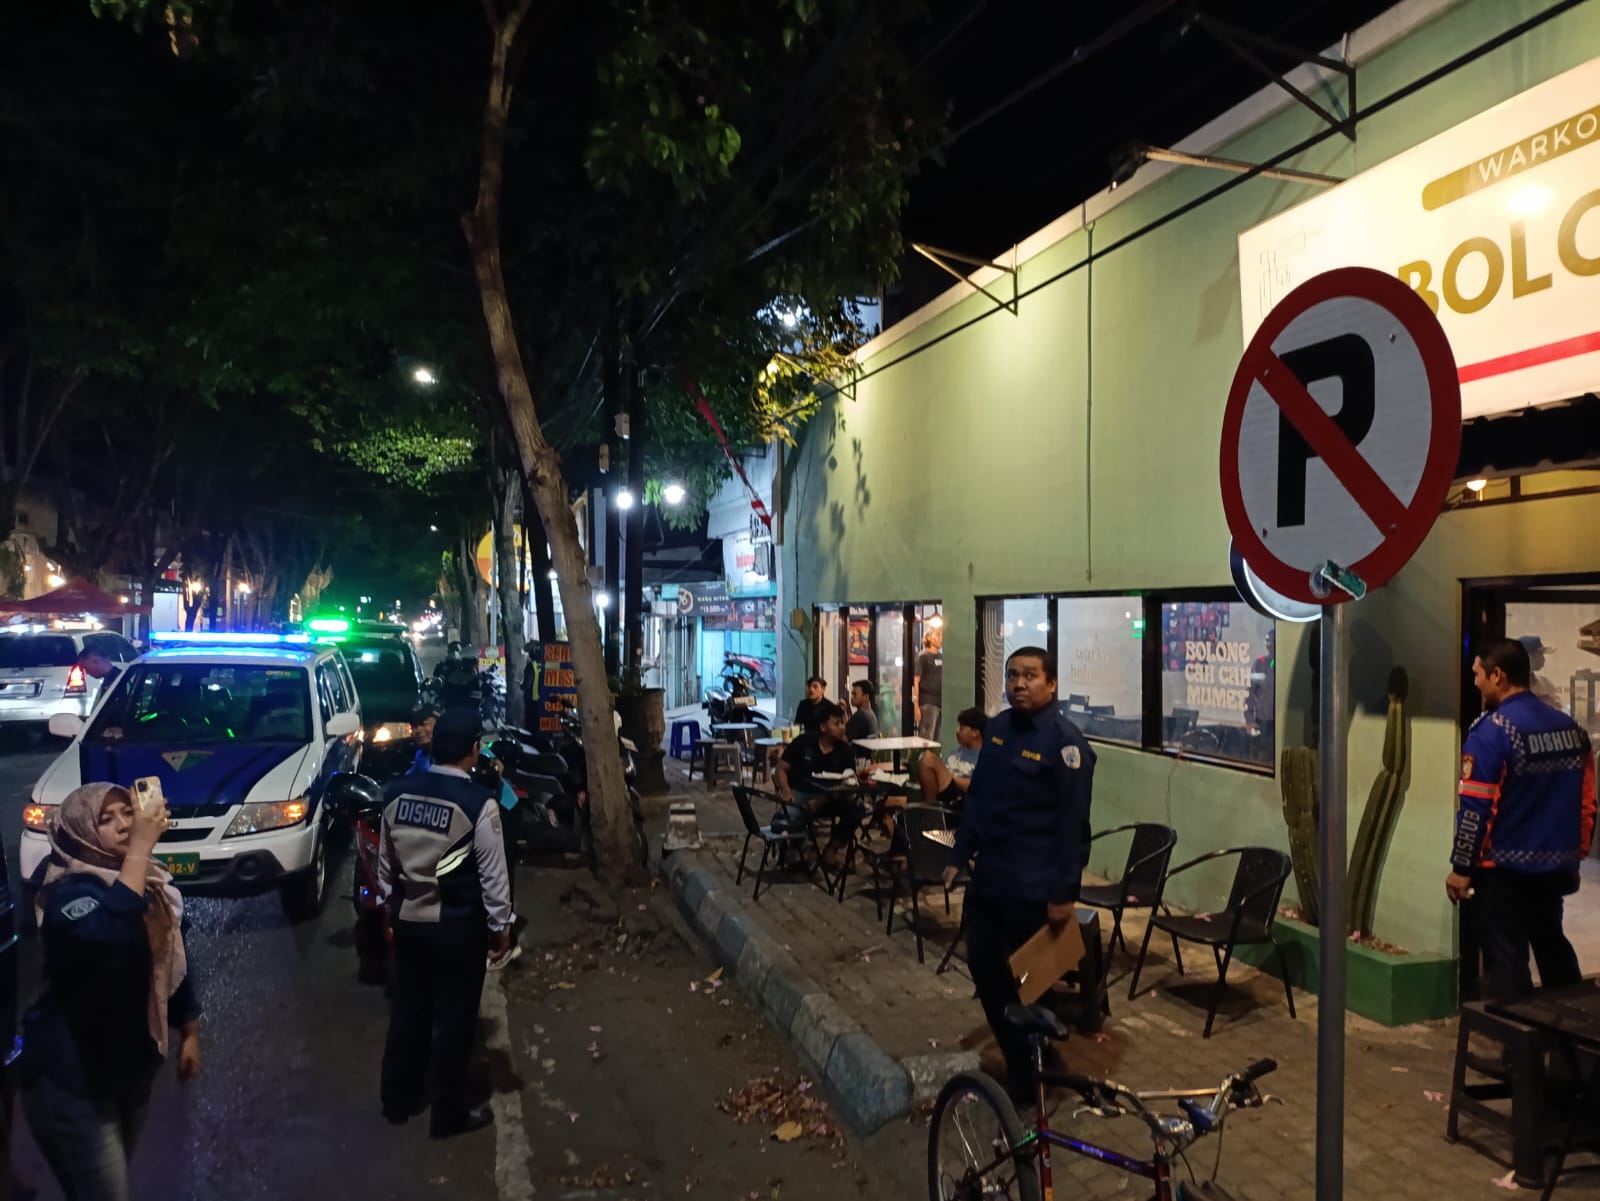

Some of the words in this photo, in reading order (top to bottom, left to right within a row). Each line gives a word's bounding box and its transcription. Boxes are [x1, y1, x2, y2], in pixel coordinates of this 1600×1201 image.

[1478, 113, 1598, 183] WARKO
[1277, 333, 1375, 527] P
[397, 800, 451, 829] DISHUB
[1453, 809, 1480, 867] DISHUB
